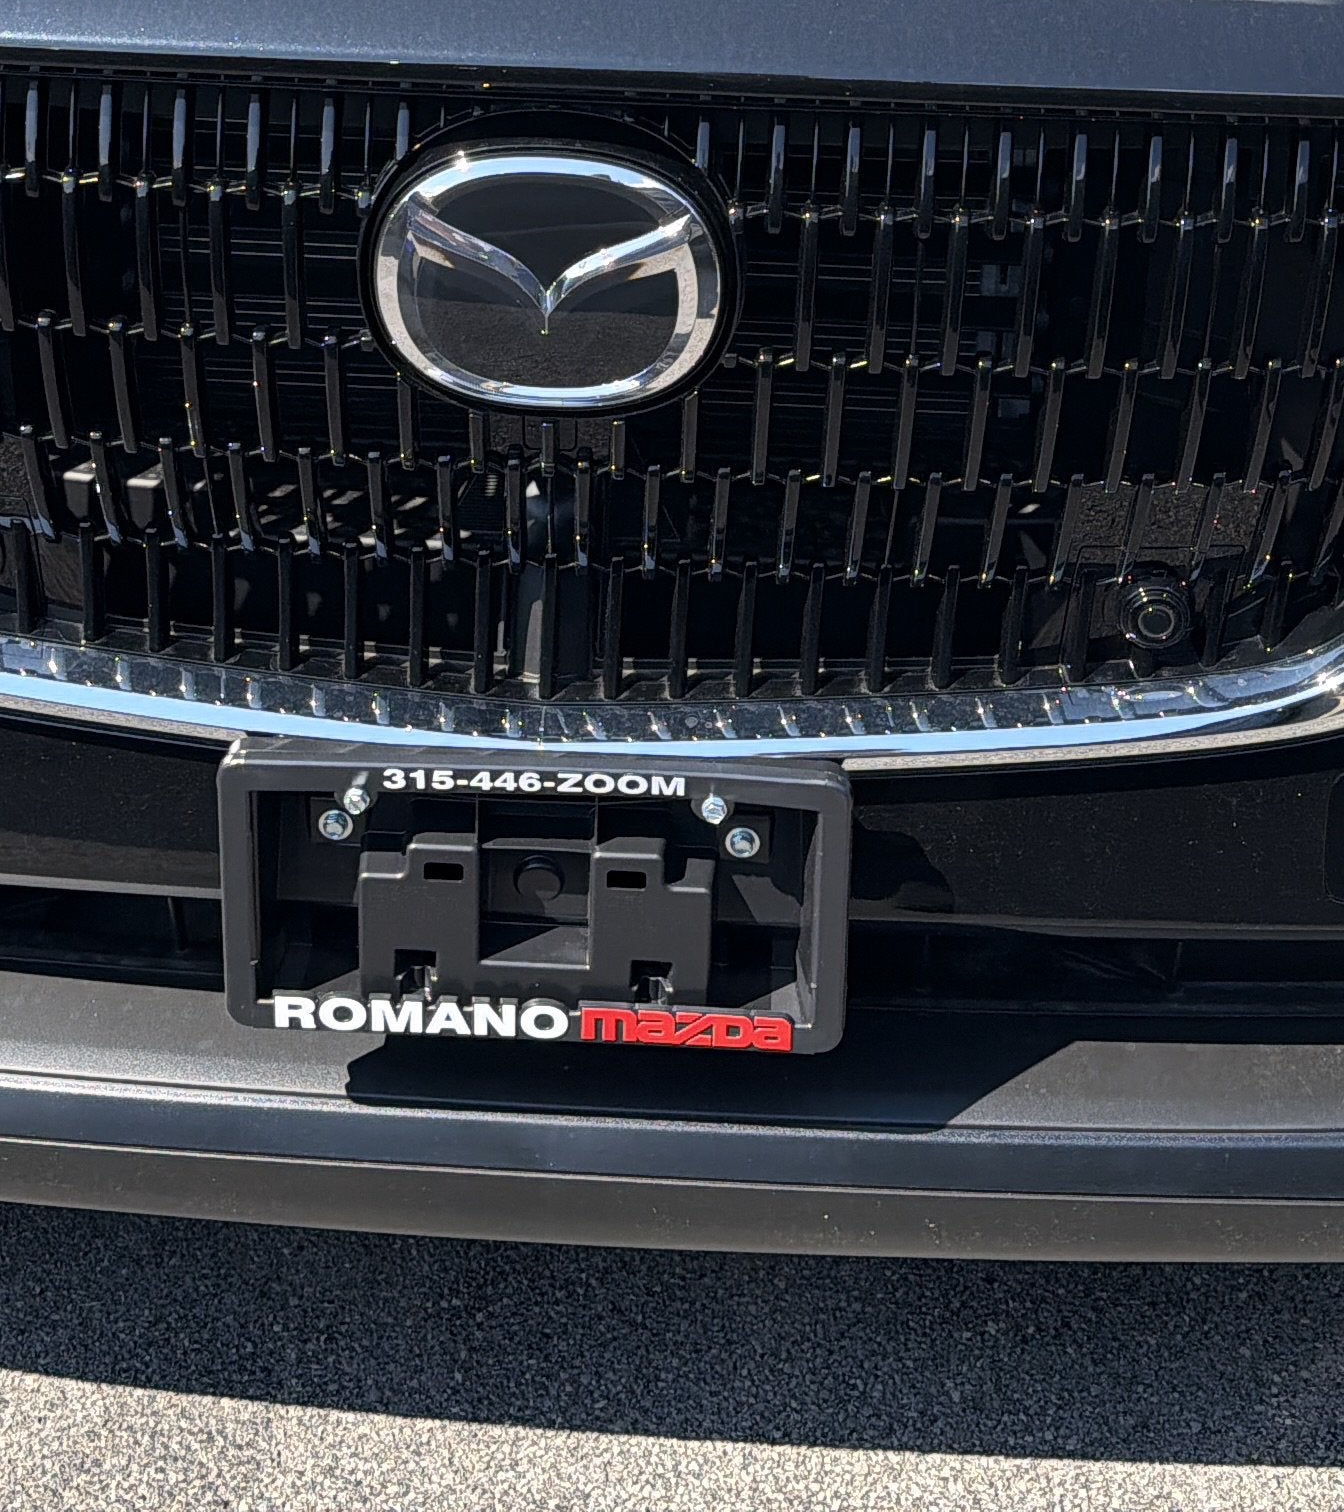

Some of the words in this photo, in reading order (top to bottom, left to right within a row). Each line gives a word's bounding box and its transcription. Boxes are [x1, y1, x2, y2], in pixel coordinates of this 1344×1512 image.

[382, 768, 686, 797] 315-446-ZOOM
[273, 995, 569, 1040] ROMANO
[580, 1007, 793, 1052] mazda
